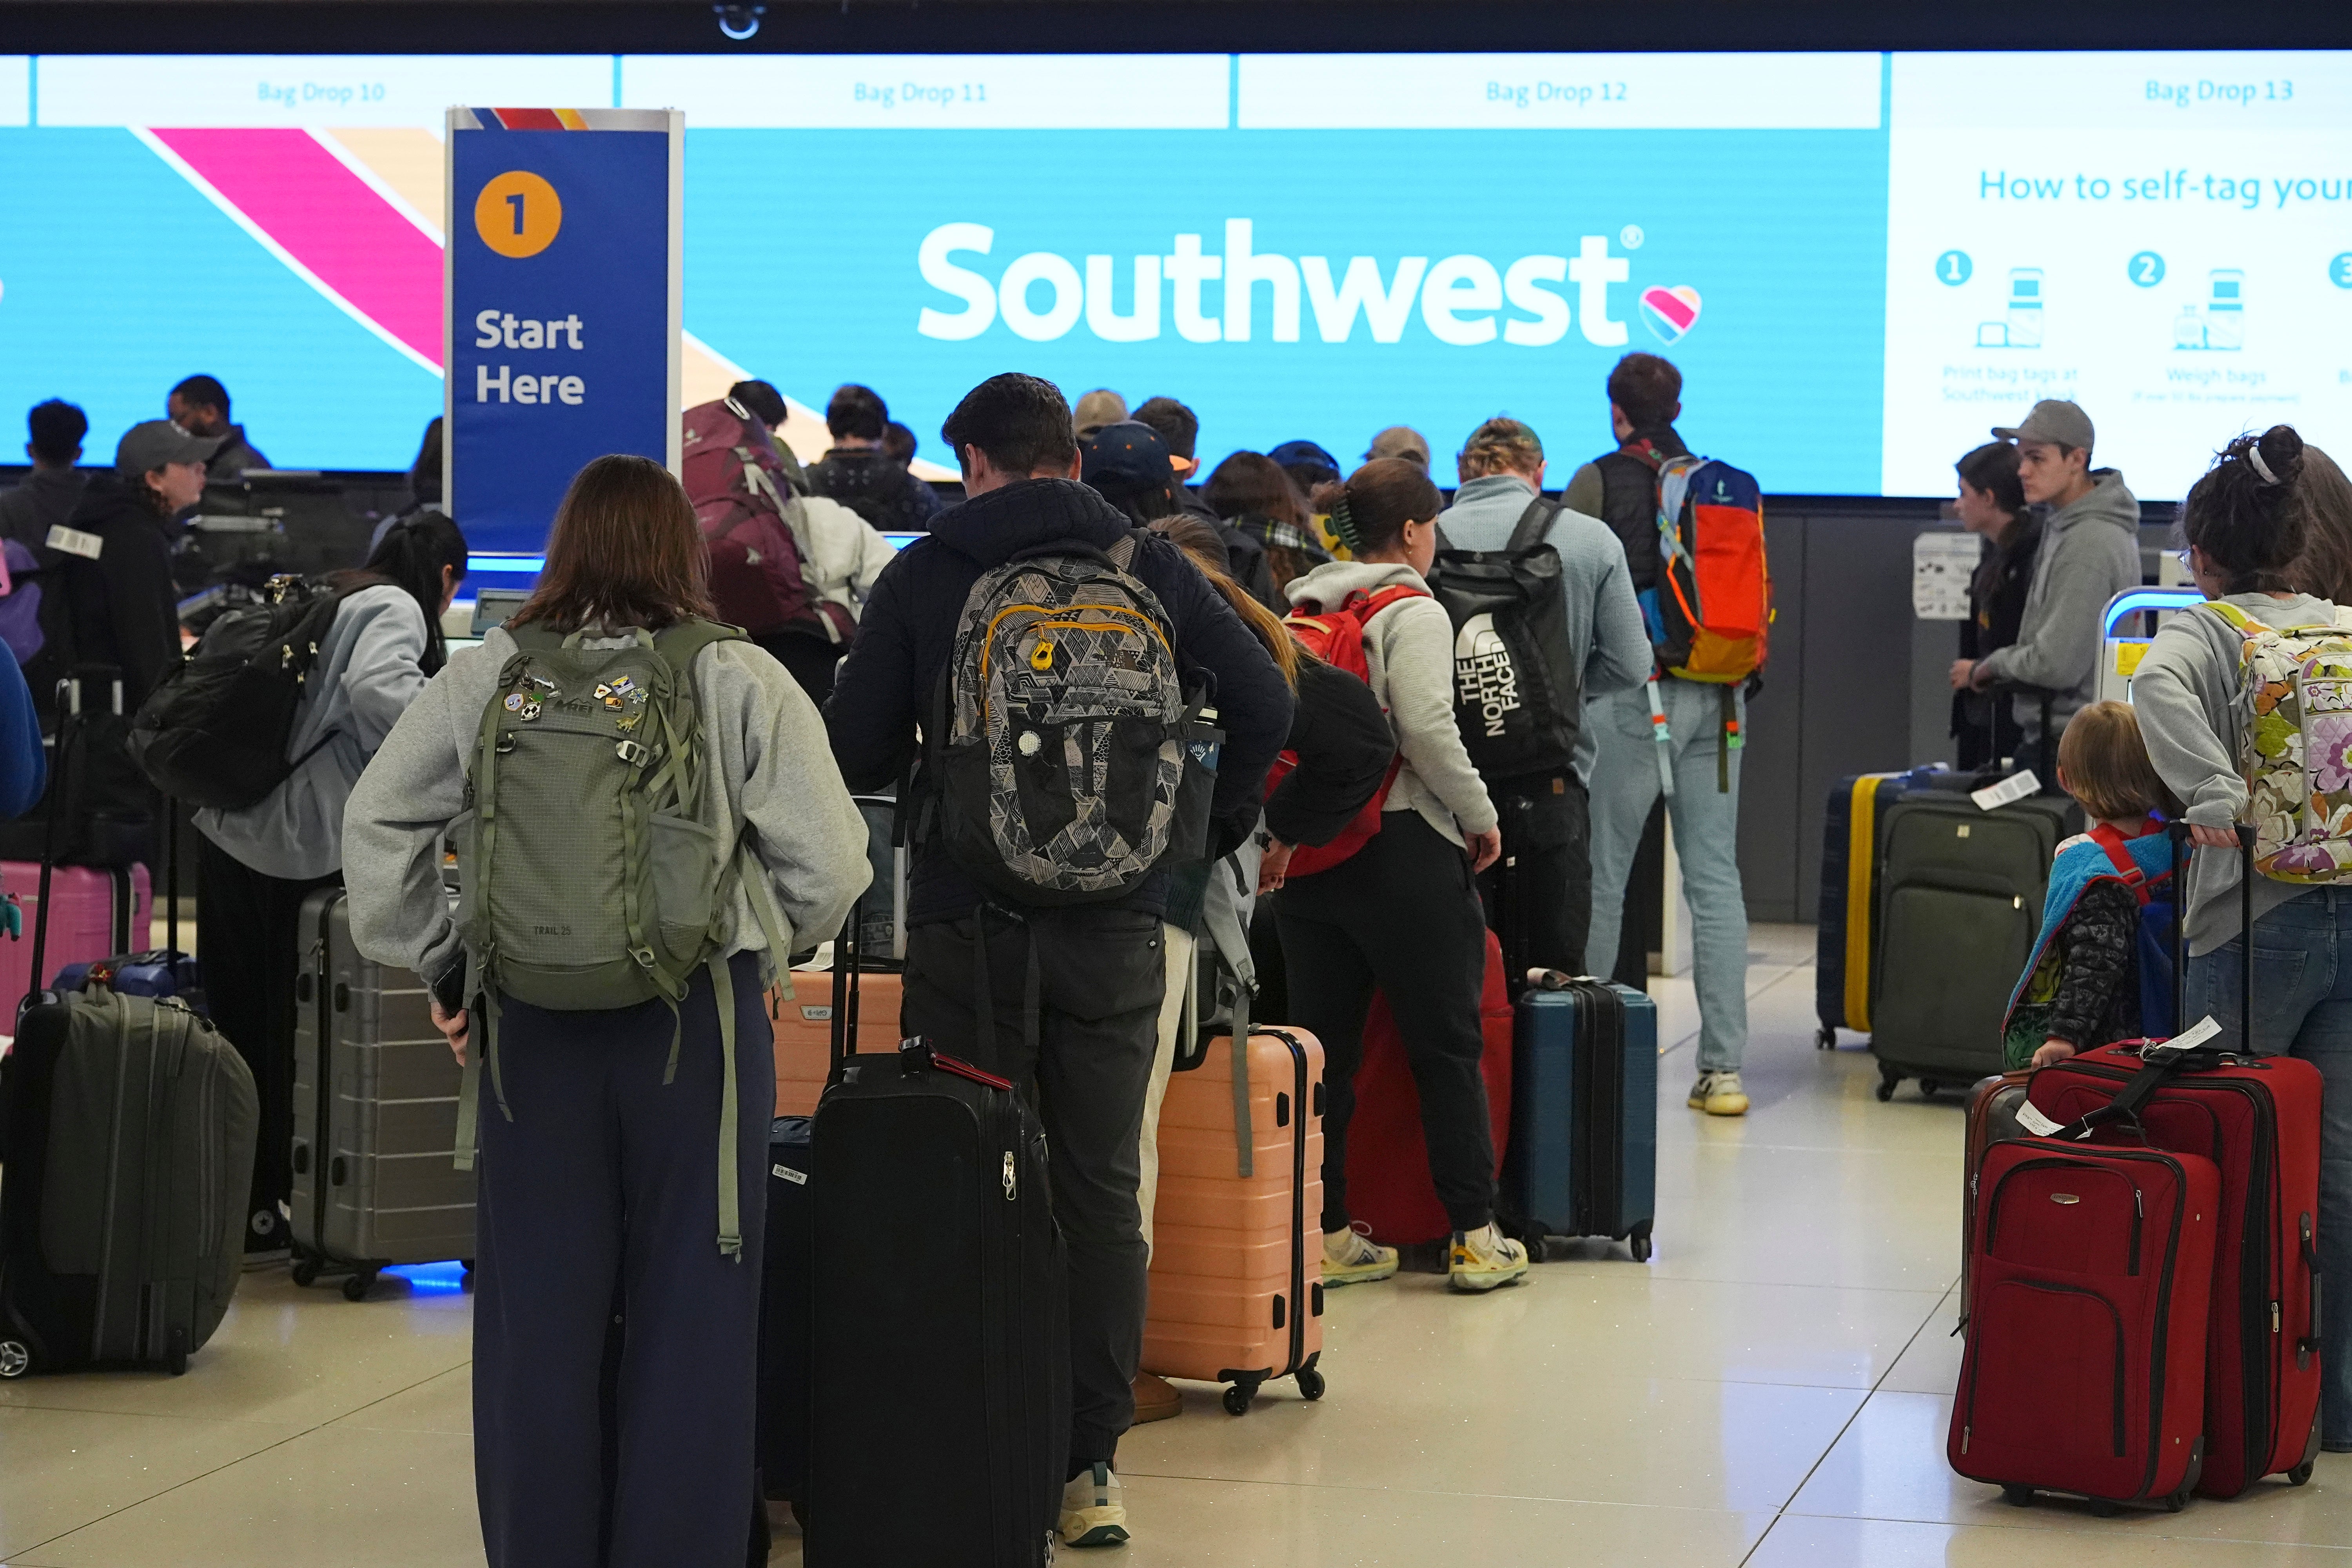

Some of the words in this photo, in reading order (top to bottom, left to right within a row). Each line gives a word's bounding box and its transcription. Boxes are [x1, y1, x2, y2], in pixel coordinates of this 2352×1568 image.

[258, 83, 296, 107] Bag
[304, 83, 354, 105] Drop
[361, 83, 385, 102] 10
[855, 83, 895, 108] Bag
[903, 83, 955, 106] Drop
[964, 84, 986, 102] 11
[1487, 82, 1530, 109] Bag
[1537, 82, 1593, 107] Drop
[1602, 83, 1628, 101] 12
[2146, 81, 2190, 108] Bag
[2198, 80, 2257, 107] Drop
[2265, 80, 2294, 101] 13
[1981, 171, 2064, 200] How
[2075, 174, 2111, 200] to
[2123, 169, 2261, 210] self-tag
[506, 194, 525, 235] 1
[918, 218, 1630, 347] Southwest
[2138, 256, 2156, 282] 2
[476, 310, 583, 350] Start
[477, 366, 585, 405] Here
[1943, 365, 1983, 381] Print
[1987, 367, 2019, 385] bag
[2166, 368, 2222, 388] Weigh
[2227, 368, 2267, 388] bags
[1455, 659, 1481, 705] THE
[1475, 655, 1505, 737] NORTH
[1492, 652, 1521, 711] FACE
[534, 926, 558, 935] TRAIL
[561, 926, 571, 935] 25
